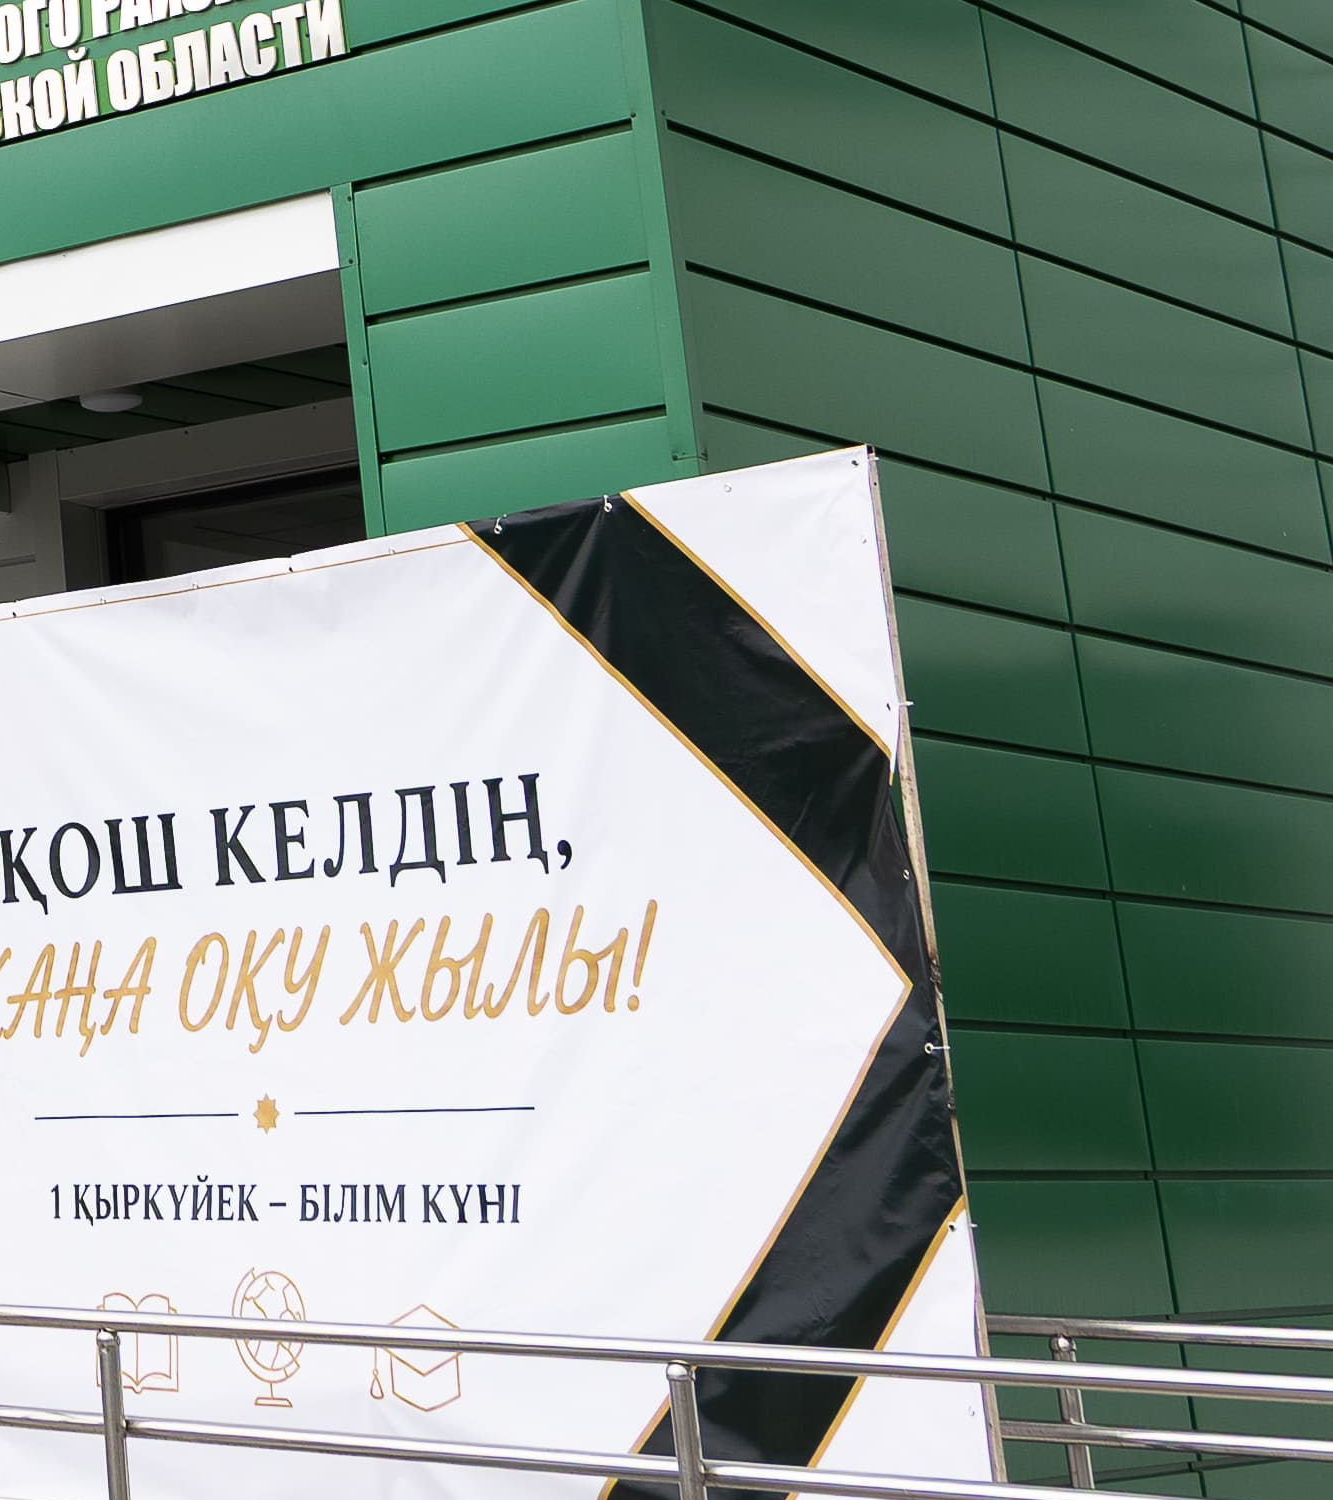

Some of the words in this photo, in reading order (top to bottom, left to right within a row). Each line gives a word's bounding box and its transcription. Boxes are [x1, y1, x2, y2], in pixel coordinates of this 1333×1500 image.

[209, 772, 573, 887] КЕЛДІҢ,
[179, 924, 331, 1054] ОҚУ
[339, 899, 657, 1026] ЖЫЛЫ!
[50, 1184, 61, 1219] 1
[73, 1175, 259, 1226] ҚЫРКҮЙЕК
[299, 1184, 407, 1223] БІЛІМ
[422, 1184, 521, 1223] КҮНІ
